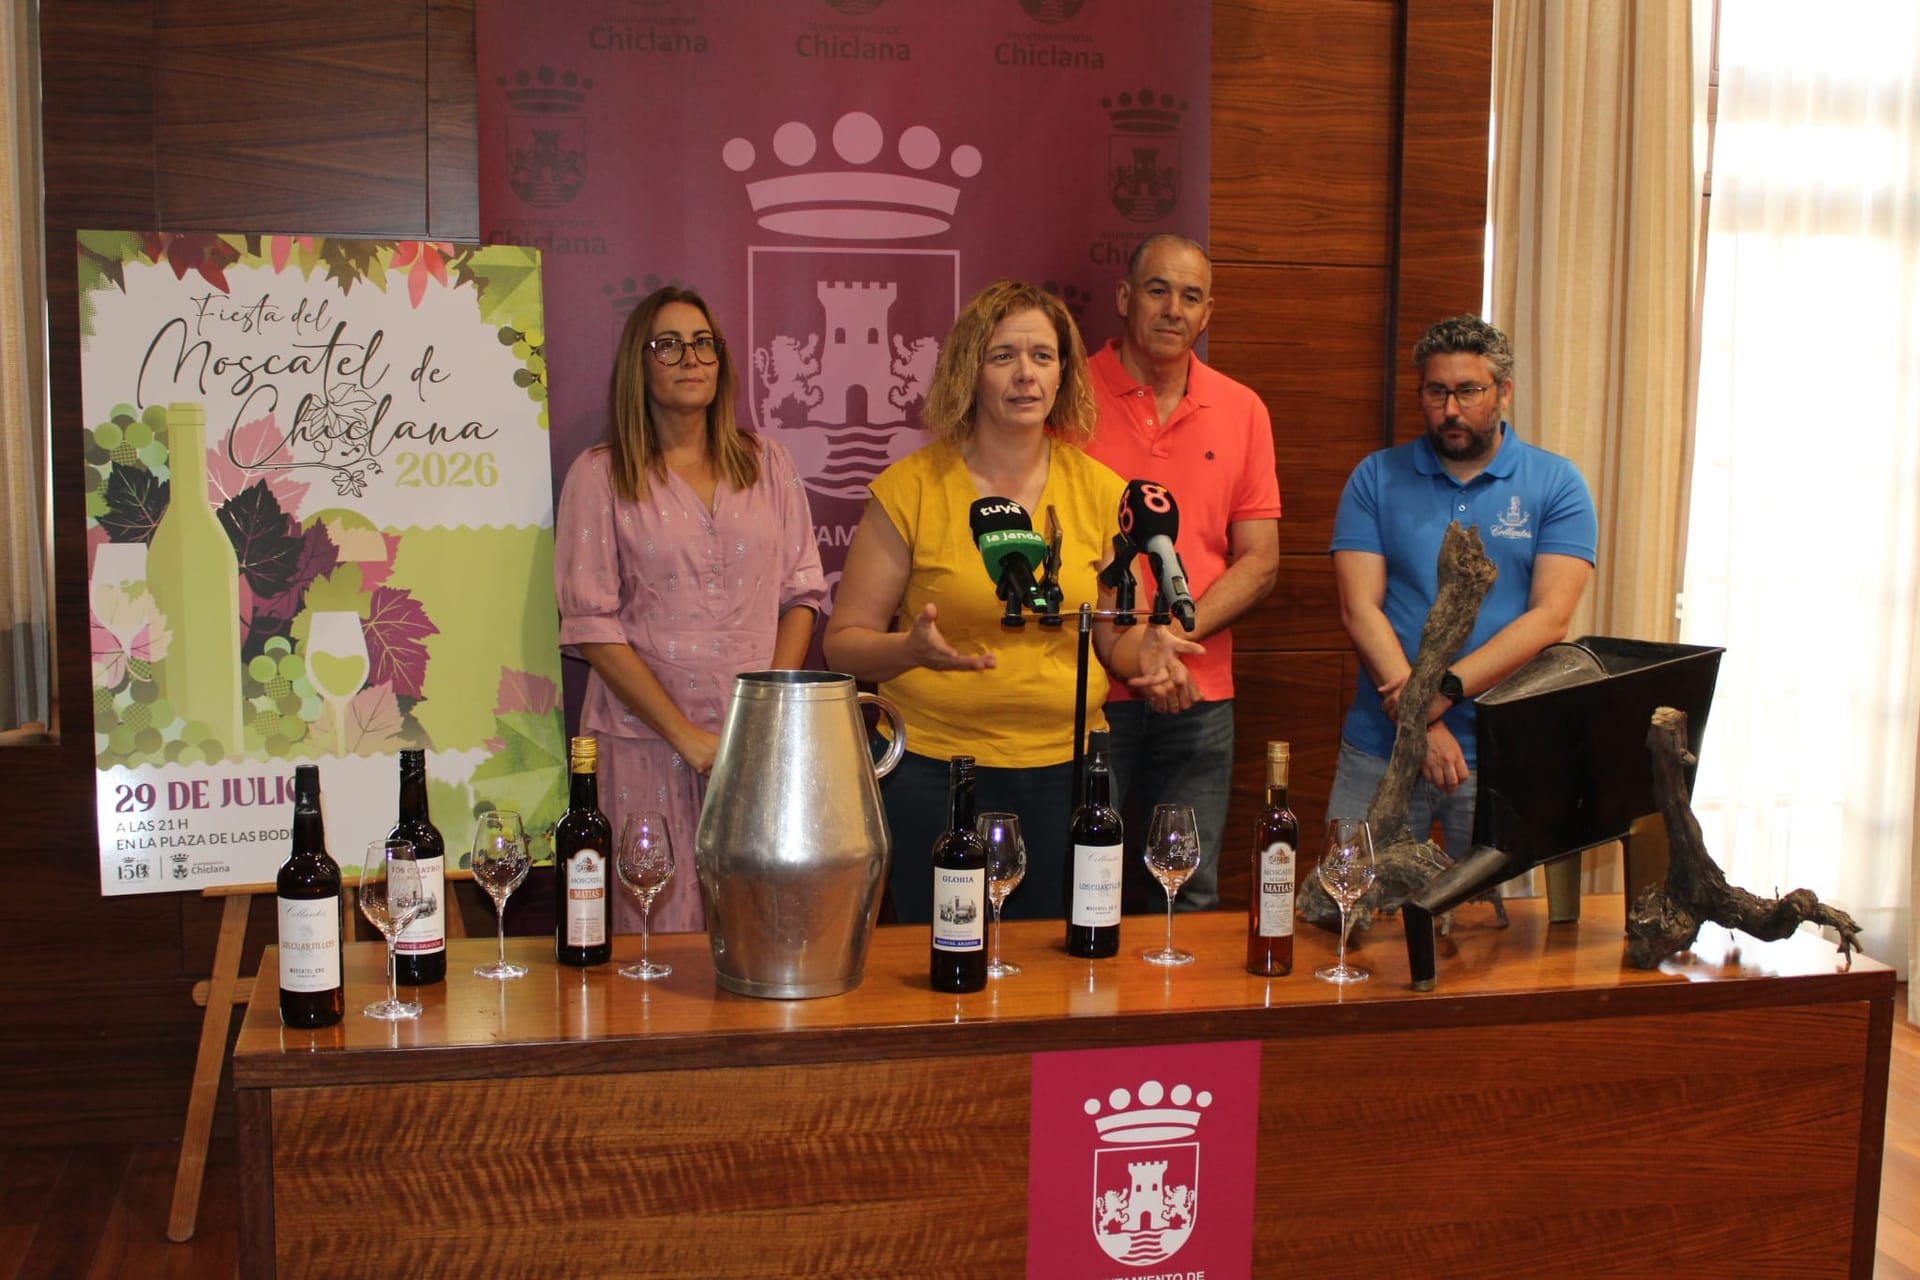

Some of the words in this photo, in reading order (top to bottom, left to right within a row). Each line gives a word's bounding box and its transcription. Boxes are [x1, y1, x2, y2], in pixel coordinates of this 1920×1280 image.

[588, 25, 709, 53] Chiclana
[796, 33, 911, 61] Chiclana
[994, 42, 1105, 70] Chiclana
[190, 292, 286, 336] Fiesta
[290, 298, 331, 333] del
[136, 317, 391, 410] Moscatel
[410, 345, 452, 402] de
[228, 382, 499, 469] Chiclana
[395, 451, 499, 488] 2026
[1141, 484, 1171, 513] 8
[115, 783, 157, 813] 29
[168, 780, 210, 811] DE
[116, 822, 126, 834] A
[129, 819, 155, 833] LAS
[158, 819, 174, 832] 21
[177, 818, 189, 830] H
[117, 838, 136, 851] EN
[139, 837, 157, 849] LA
[160, 834, 206, 848] PLAZA
[210, 832, 228, 844] DE
[231, 830, 256, 844] LAS
[191, 864, 230, 875] Chiclana
[942, 875, 974, 883] GLORIA
